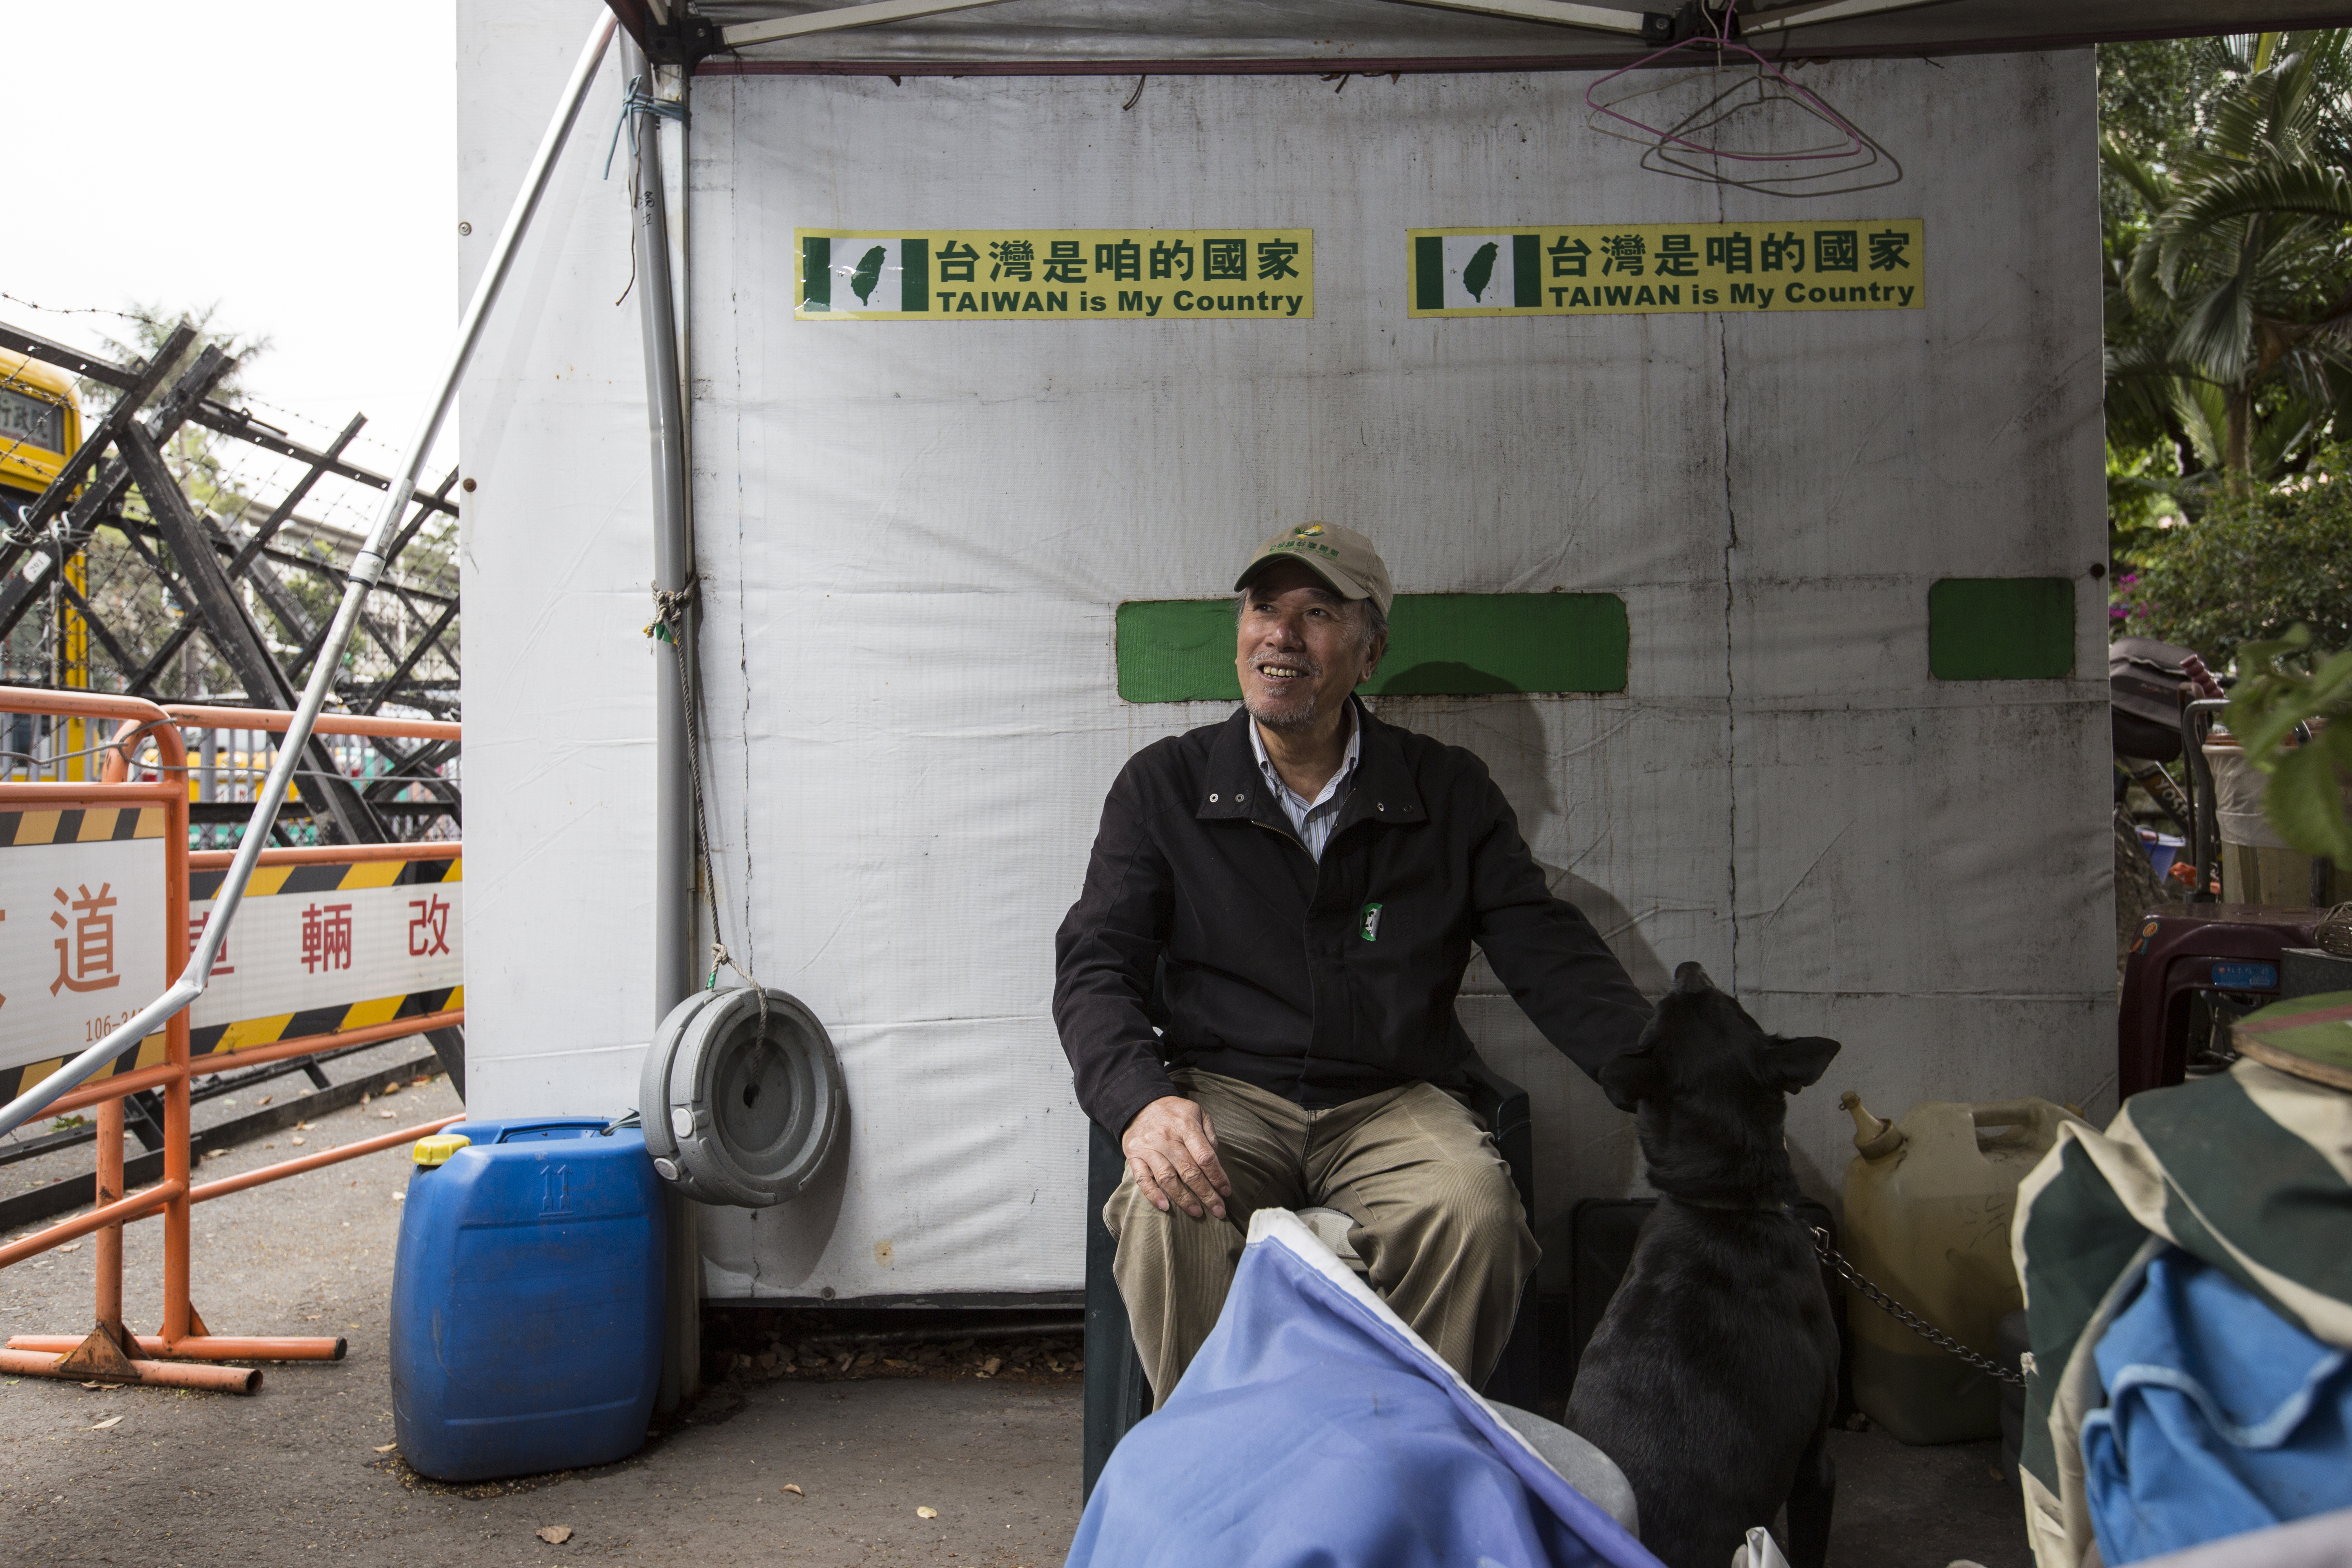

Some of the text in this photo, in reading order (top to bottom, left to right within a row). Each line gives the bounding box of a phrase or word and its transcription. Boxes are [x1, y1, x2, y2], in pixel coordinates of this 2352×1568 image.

[935, 238, 1299, 283] 台灣是咱的國家
[1547, 228, 1910, 277] 台灣是咱的國家
[936, 290, 1303, 316] TAIWAN is My Country
[1548, 281, 1915, 309] TAIWAN is My Country
